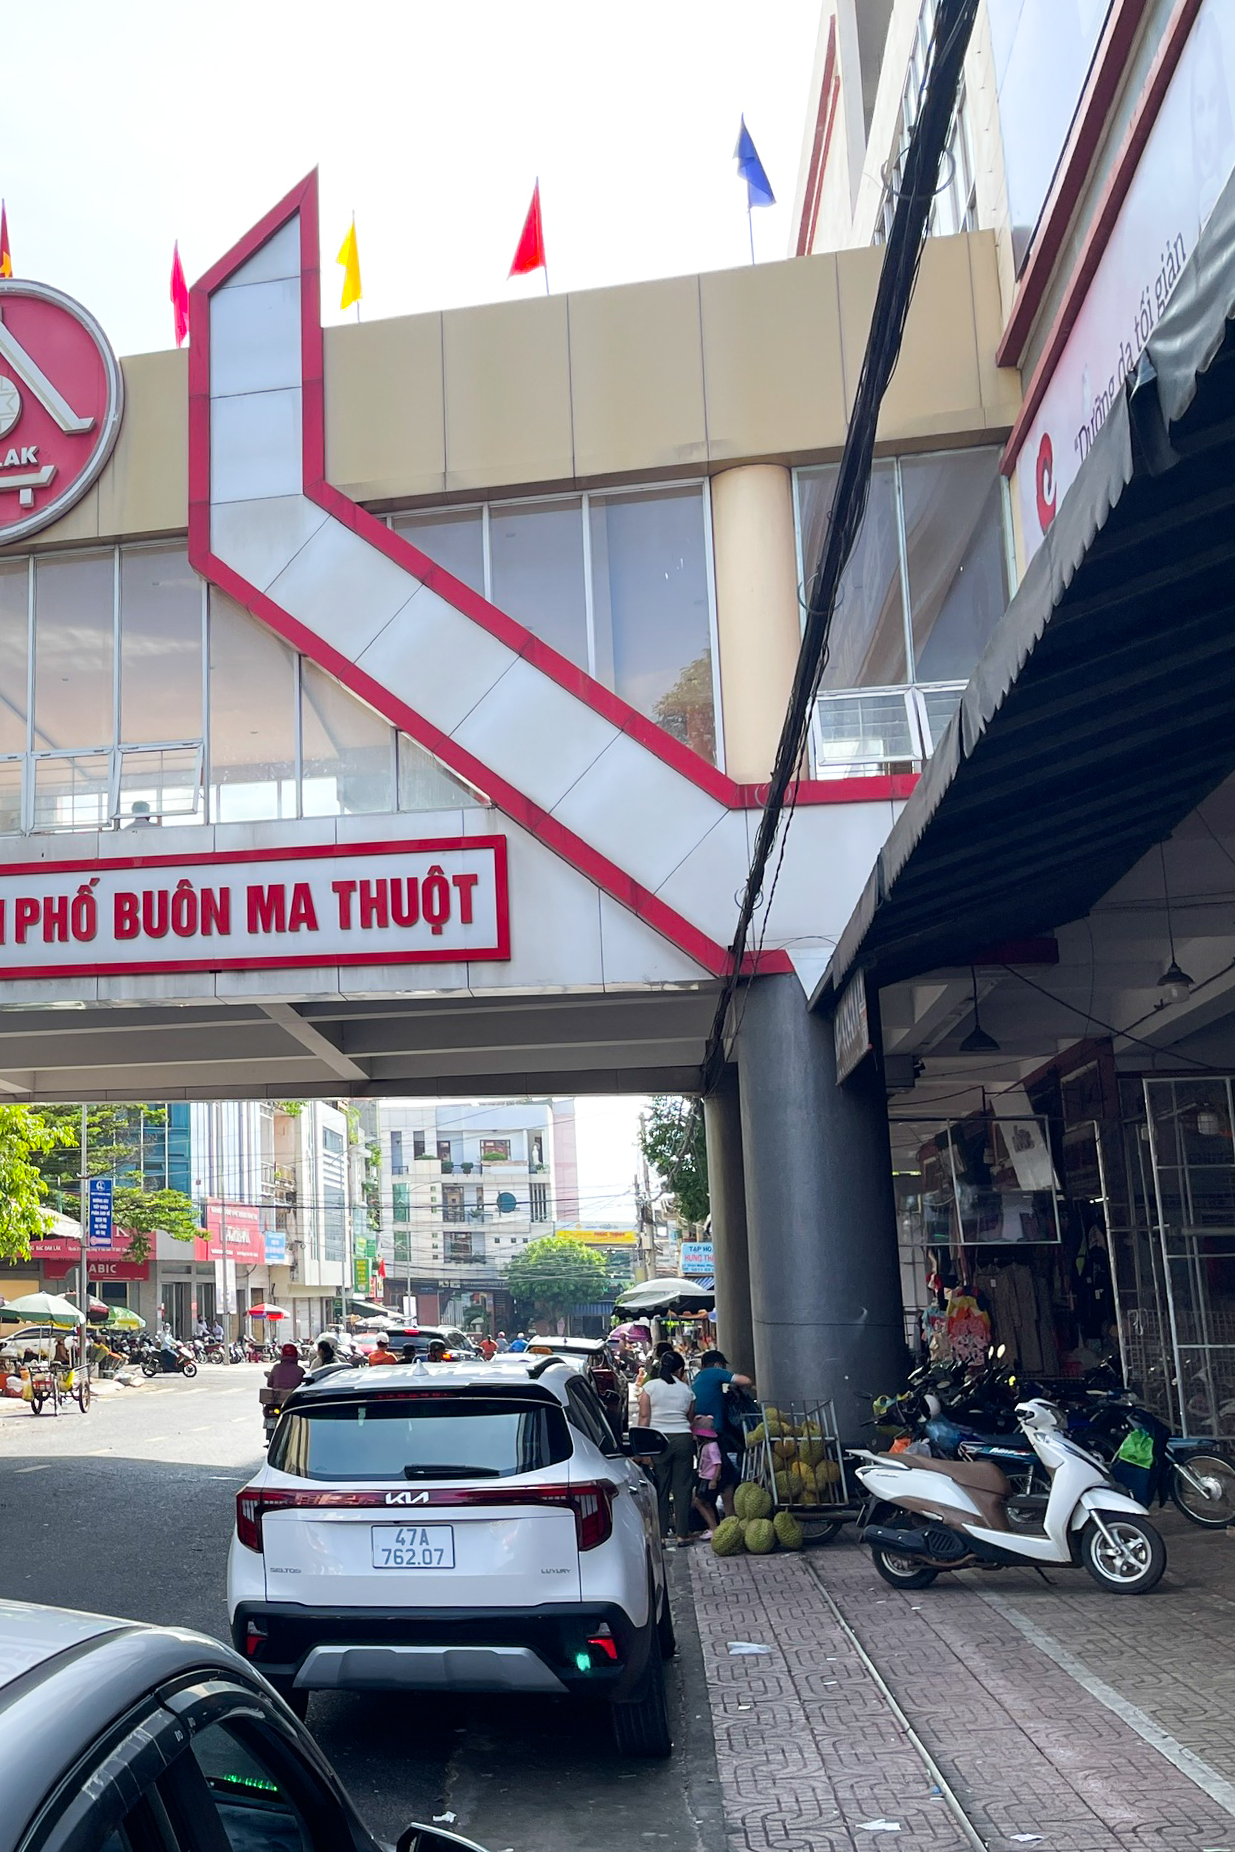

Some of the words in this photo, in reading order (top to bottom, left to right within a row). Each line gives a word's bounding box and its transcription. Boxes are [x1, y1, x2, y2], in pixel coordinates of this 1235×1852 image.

[1117, 342, 1134, 386] da
[1135, 285, 1154, 352] tối
[1155, 232, 1186, 320] giản
[15, 877, 100, 944] PHỐ
[113, 878, 231, 941] BUÔN
[246, 882, 320, 934] MA
[332, 865, 478, 935] THUỘT
[88, 1264, 117, 1274] ABIC
[395, 1528, 429, 1546] 47A
[381, 1548, 444, 1566] 762.07
